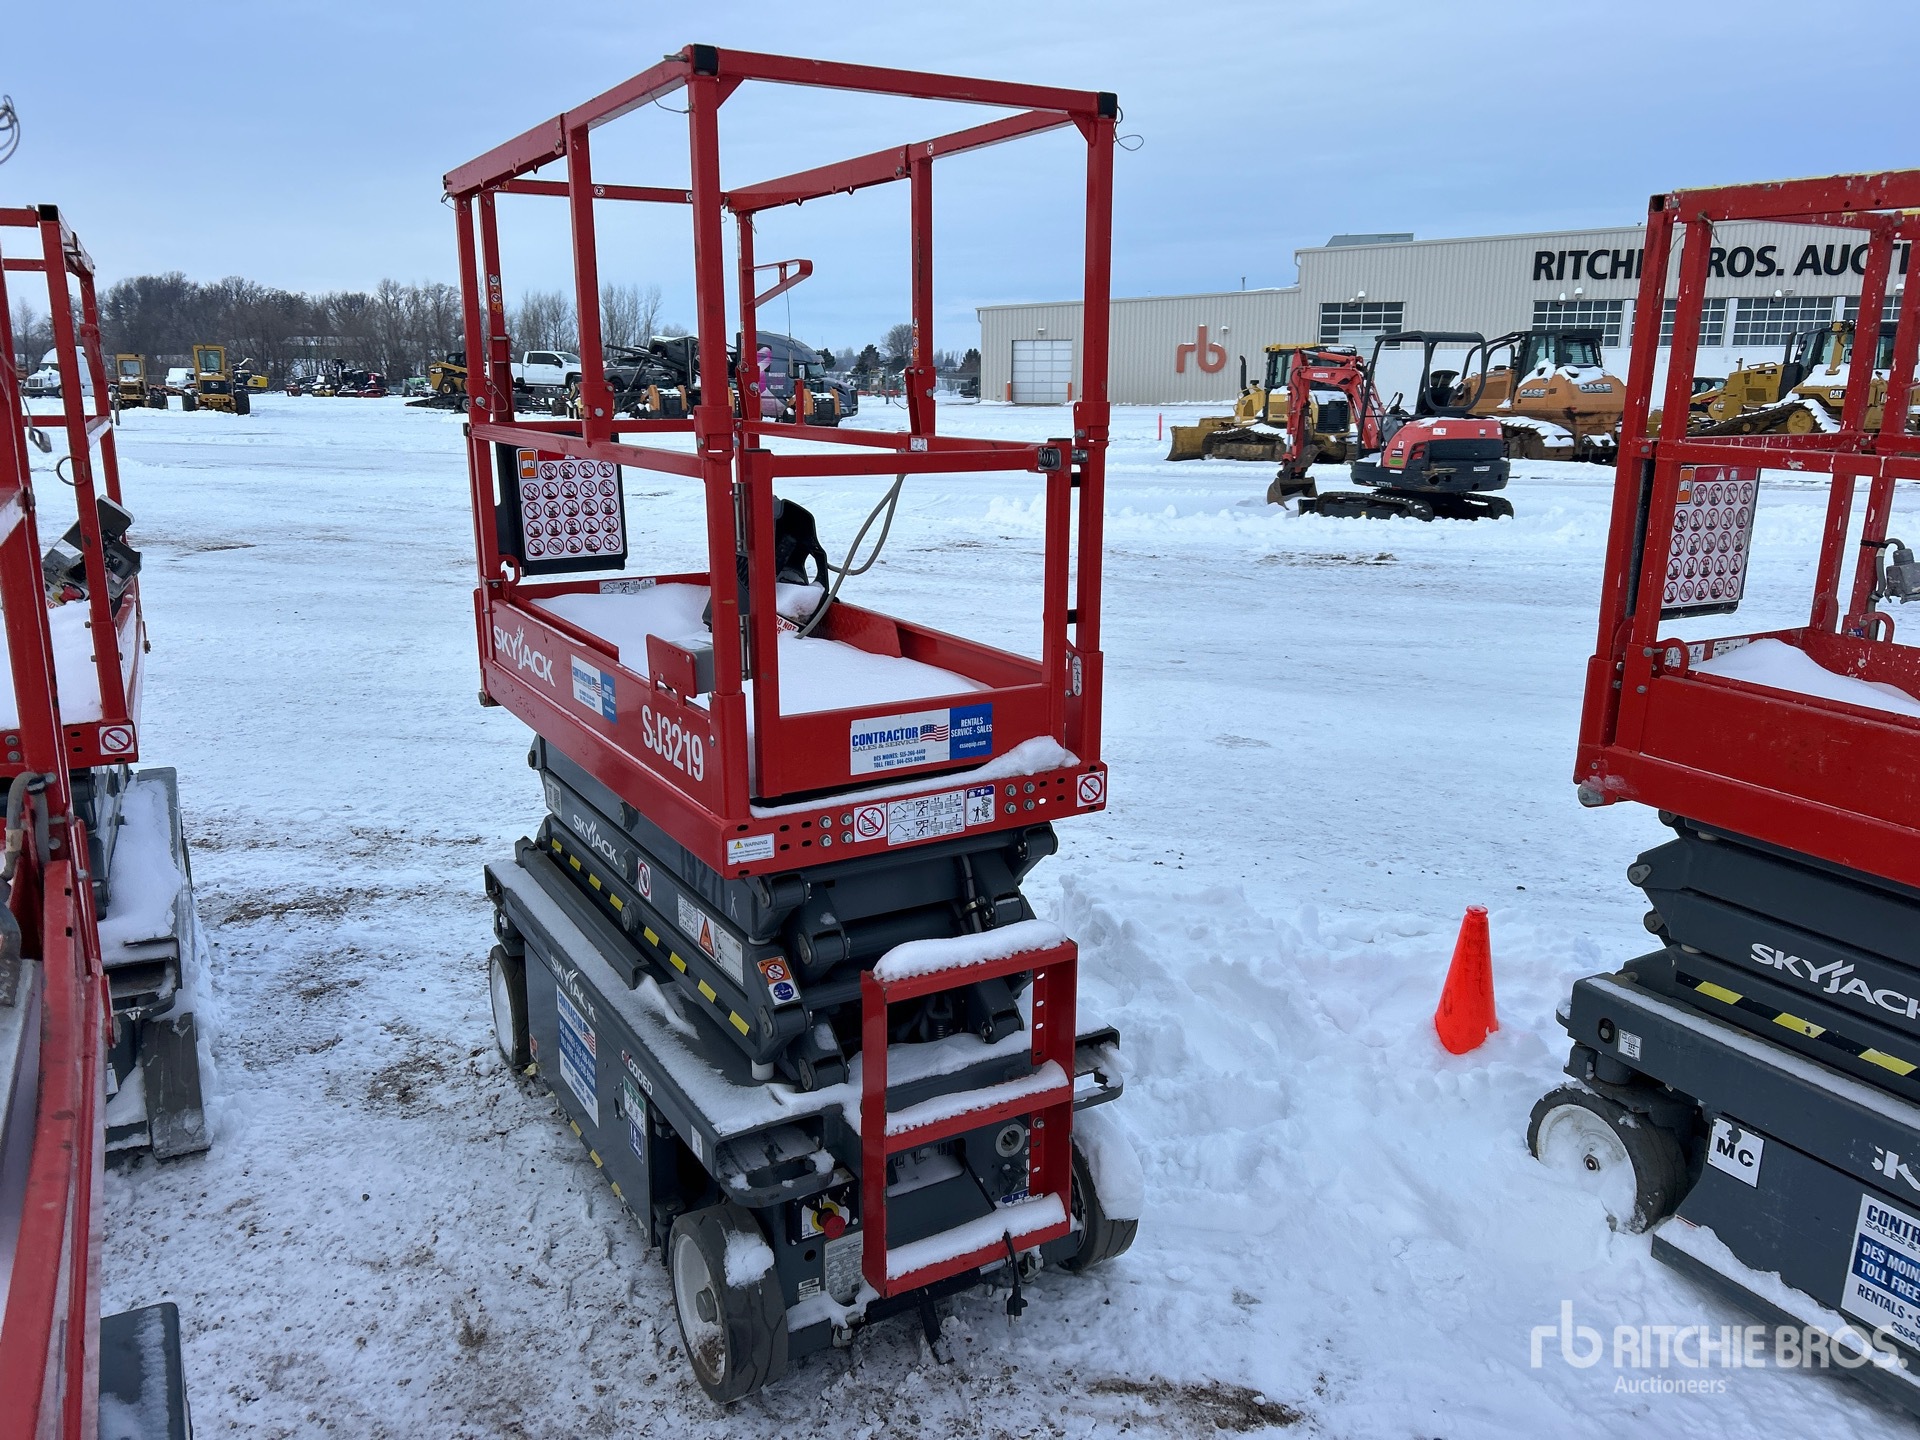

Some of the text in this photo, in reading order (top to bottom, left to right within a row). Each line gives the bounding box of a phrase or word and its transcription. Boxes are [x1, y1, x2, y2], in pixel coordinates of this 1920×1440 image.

[1533, 248, 1645, 281] RITCHI
[1679, 245, 1785, 279] ROS.
[1176, 324, 1227, 374] rb
[1520, 388, 1547, 398] CASE
[1579, 383, 1613, 394] CASE
[1829, 389, 1844, 399] CAT
[493, 624, 556, 688] SKYJACK
[950, 723, 993, 738] SERVICE SALES
[960, 716, 984, 728] RENTALS
[641, 704, 704, 782] SJ3219
[851, 726, 919, 747] CONTRACTOR
[852, 744, 878, 753] SALES
[885, 738, 920, 748] SERVICE
[573, 813, 619, 866] SKYJACK
[743, 839, 768, 848] WARNING
[1716, 1136, 1755, 1168] MC
[1864, 1220, 1905, 1246] SALES
[1860, 1257, 1888, 1286] TOLL
[1861, 1240, 1920, 1283] DES MOIN
[1857, 1282, 1906, 1320] RENTALS
